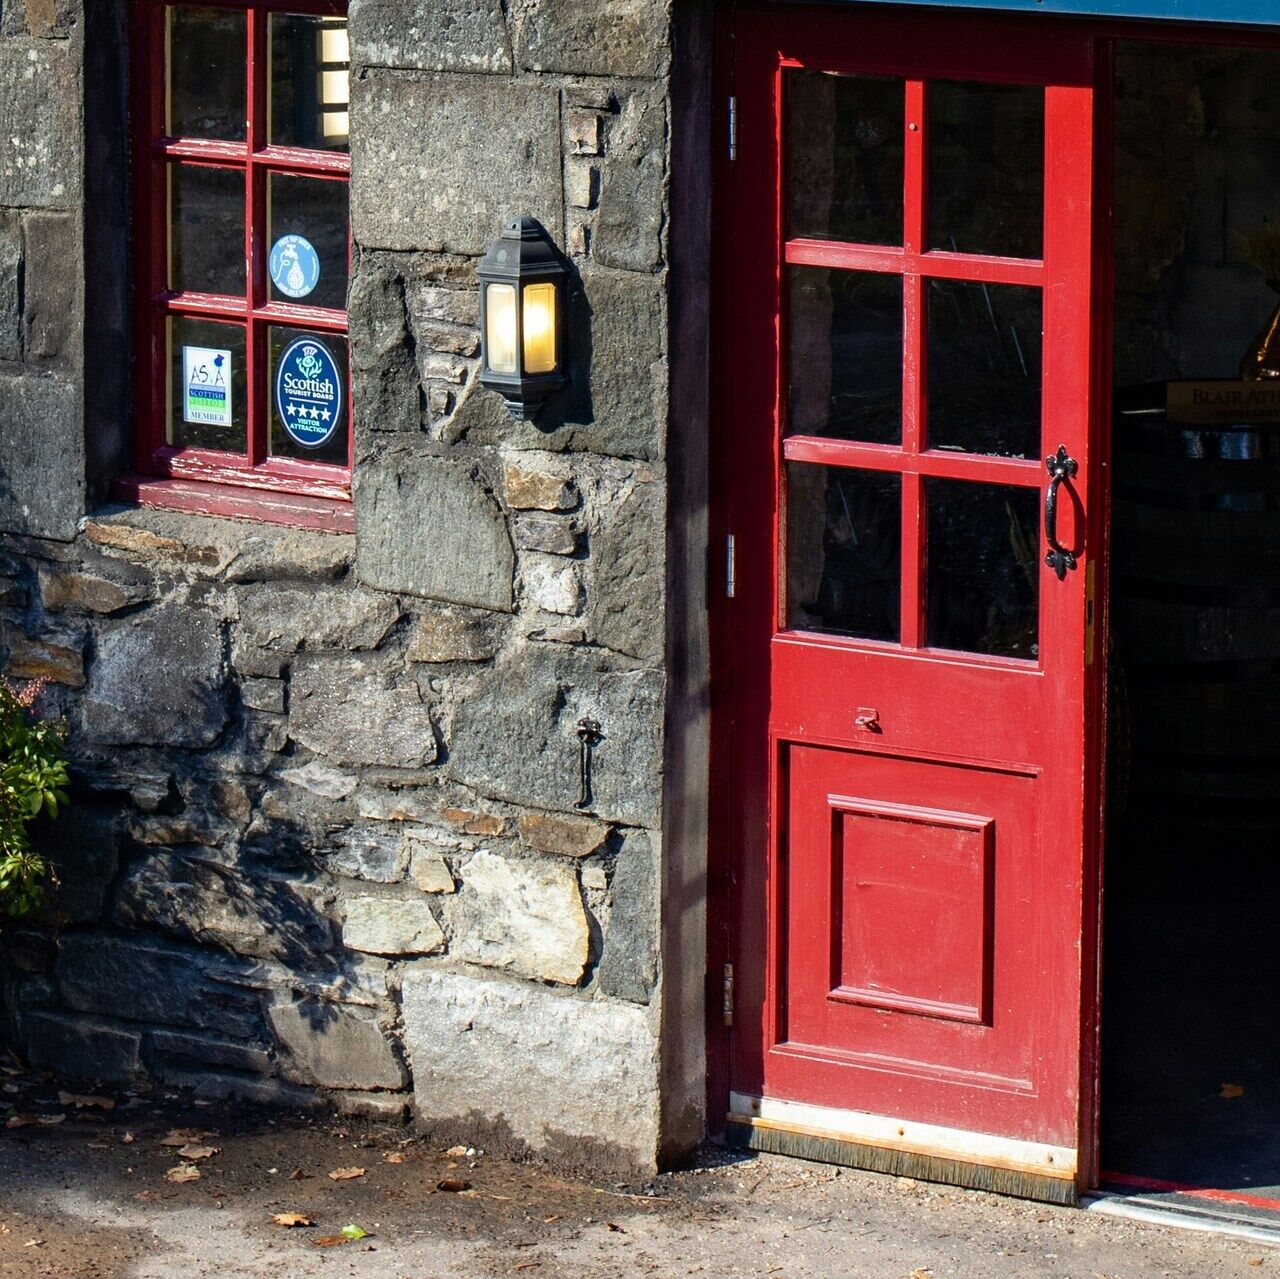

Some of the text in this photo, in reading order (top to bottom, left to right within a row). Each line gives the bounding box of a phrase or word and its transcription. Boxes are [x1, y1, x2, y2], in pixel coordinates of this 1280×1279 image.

[283, 373, 334, 394] Scottish
[189, 389, 225, 400] SCOTTISH
[284, 387, 334, 401] TOURIST BOARD
[190, 411, 225, 422] MEMBER
[297, 417, 320, 427] VISITOR
[290, 423, 328, 434] ATTRACTION
